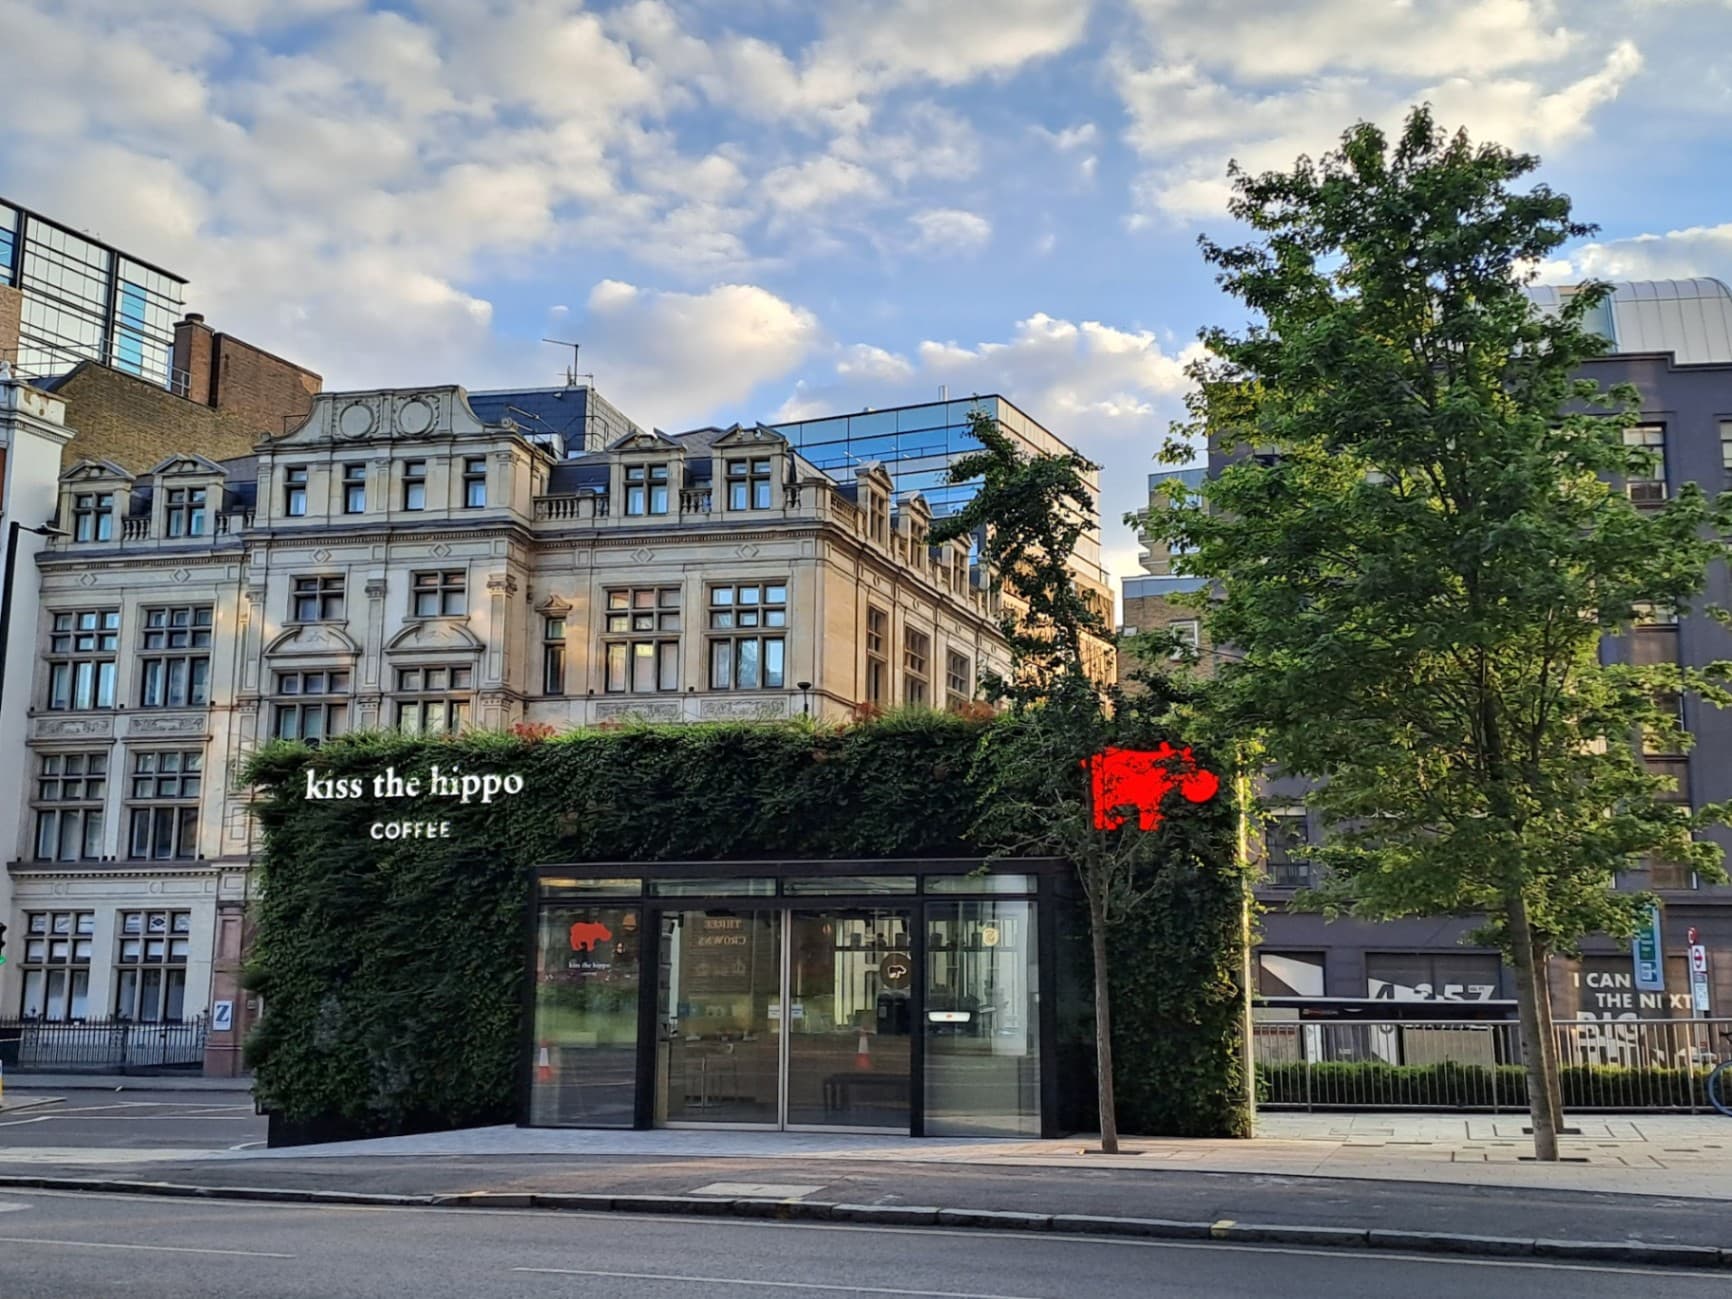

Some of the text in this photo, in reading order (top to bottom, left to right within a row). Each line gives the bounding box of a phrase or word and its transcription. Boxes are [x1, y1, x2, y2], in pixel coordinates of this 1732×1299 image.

[304, 765, 524, 804] kiss the hippo
[369, 821, 451, 840] COFFEE
[1586, 972, 1631, 988] CAN
[1595, 993, 1633, 1008] THE
[216, 1005, 229, 1021] Z
